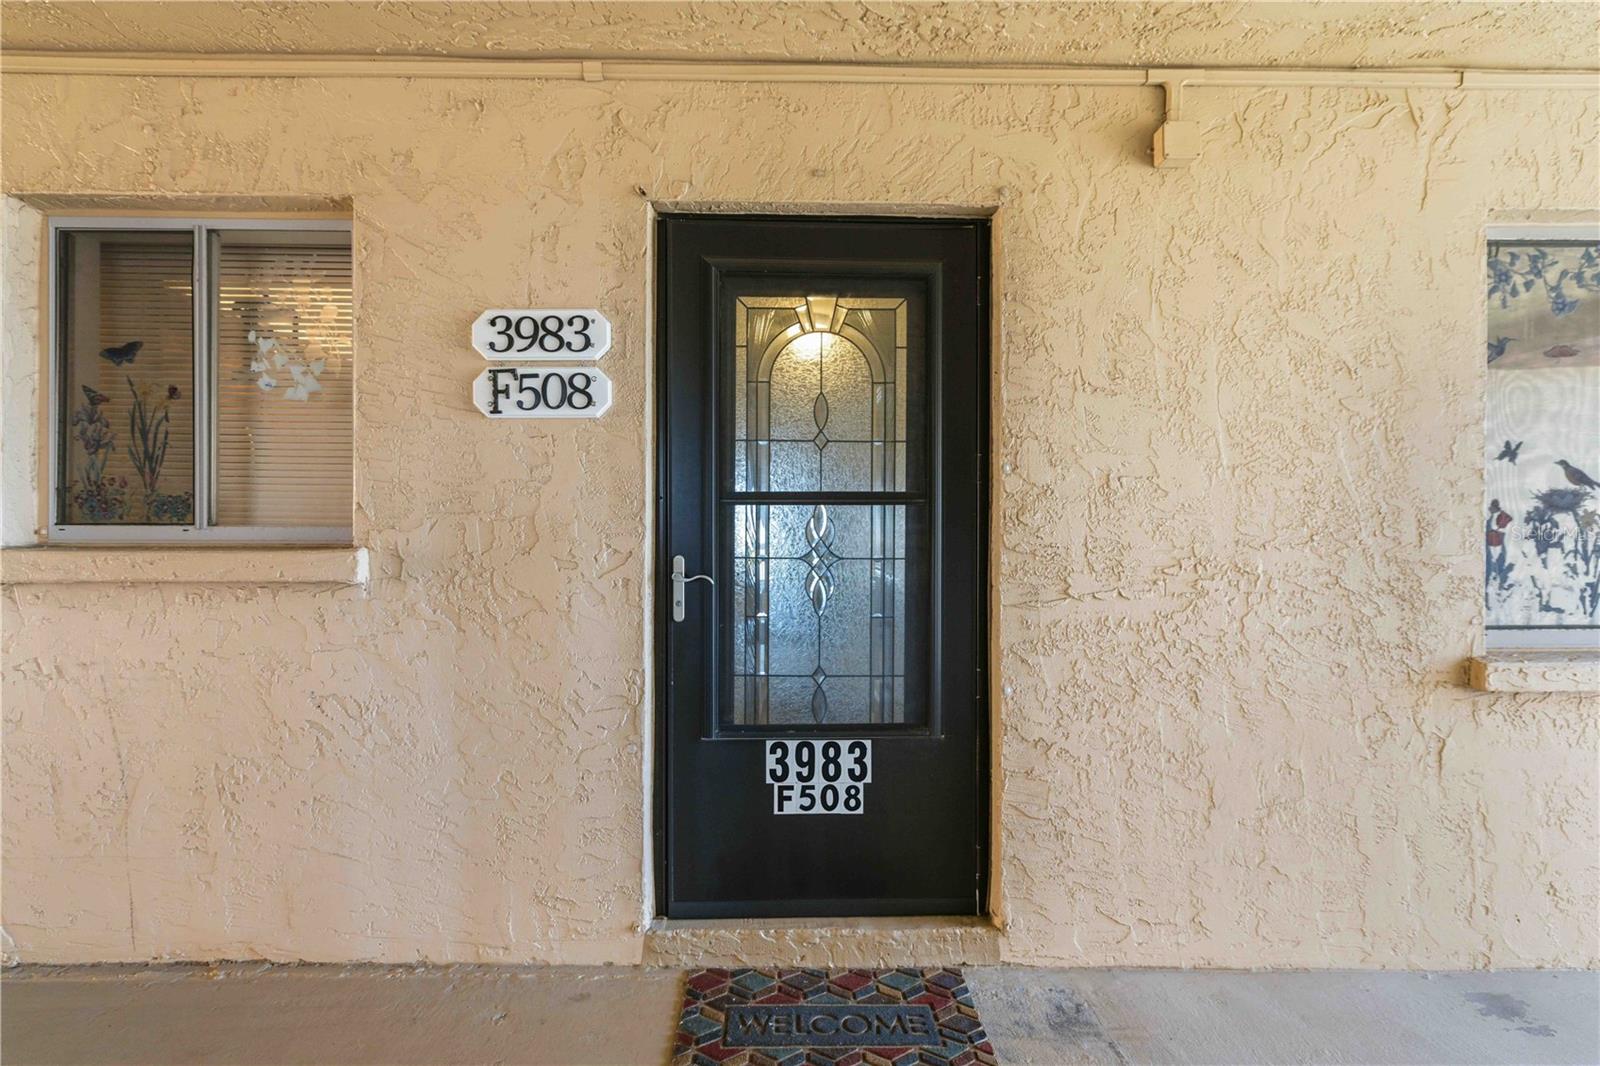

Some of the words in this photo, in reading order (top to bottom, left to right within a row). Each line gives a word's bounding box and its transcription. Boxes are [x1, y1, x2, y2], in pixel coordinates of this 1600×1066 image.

[488, 315, 591, 353] 3983
[488, 368, 593, 414] F508
[769, 741, 868, 782] 3983
[777, 784, 862, 812] F508
[738, 1013, 930, 1037] WELCOME
